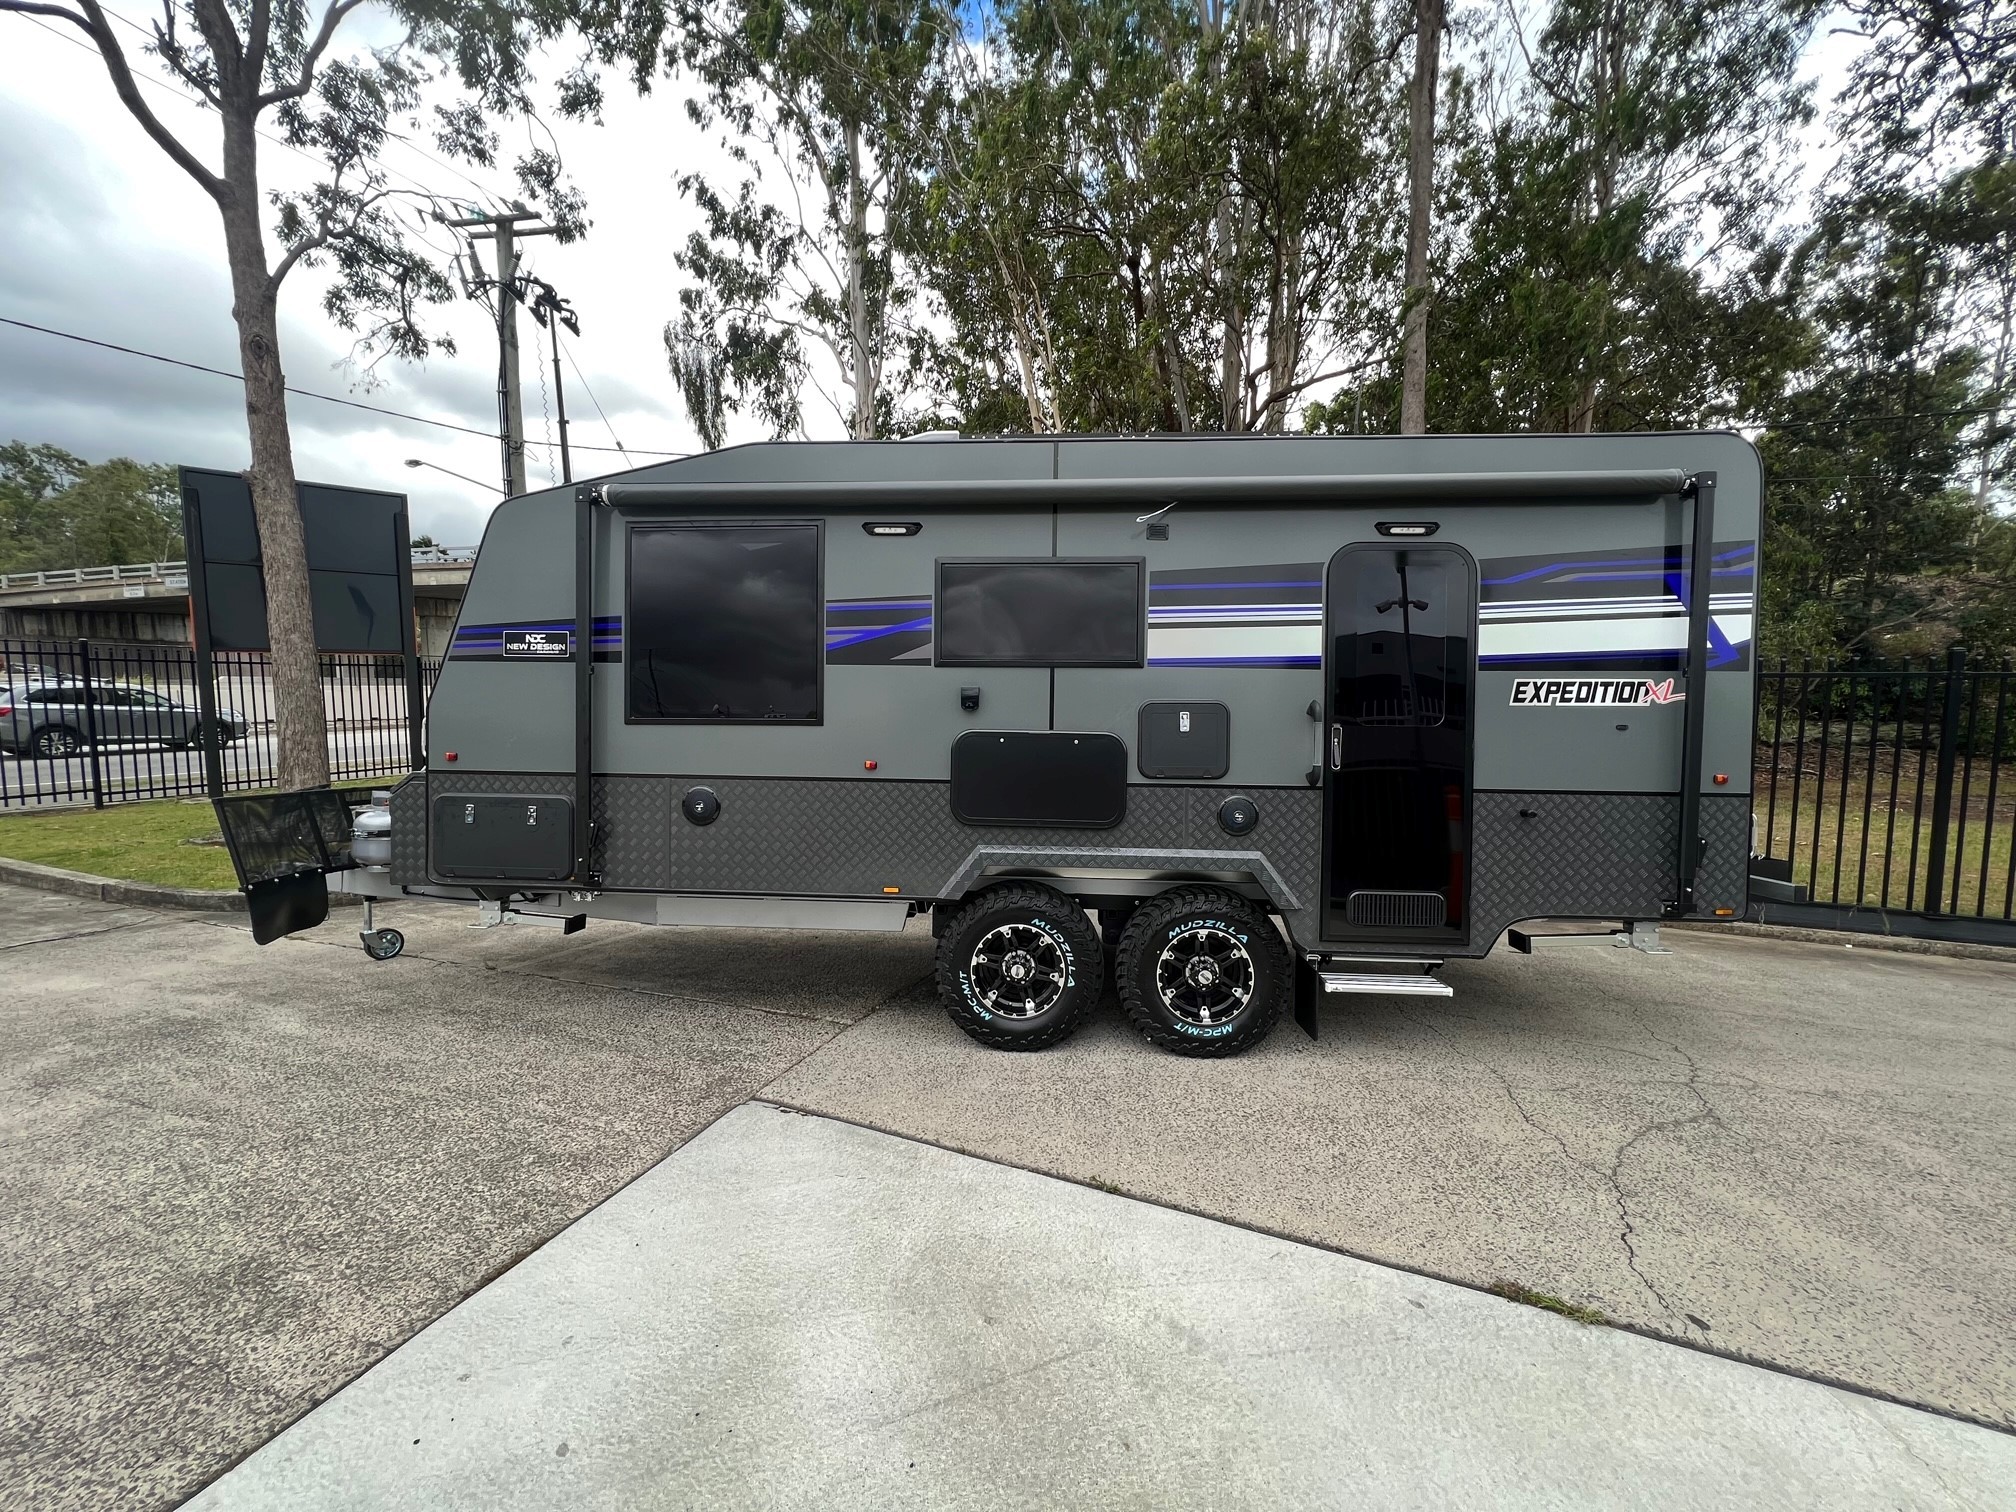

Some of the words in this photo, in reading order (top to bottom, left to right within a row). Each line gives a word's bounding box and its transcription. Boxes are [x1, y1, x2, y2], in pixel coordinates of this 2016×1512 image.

[1168, 919, 1249, 944] MUDZILLA
[1031, 918, 1076, 987] MUDZILLA
[959, 971, 993, 1021] MPC-M/T
[1173, 1022, 1234, 1037] MPC-M/T
